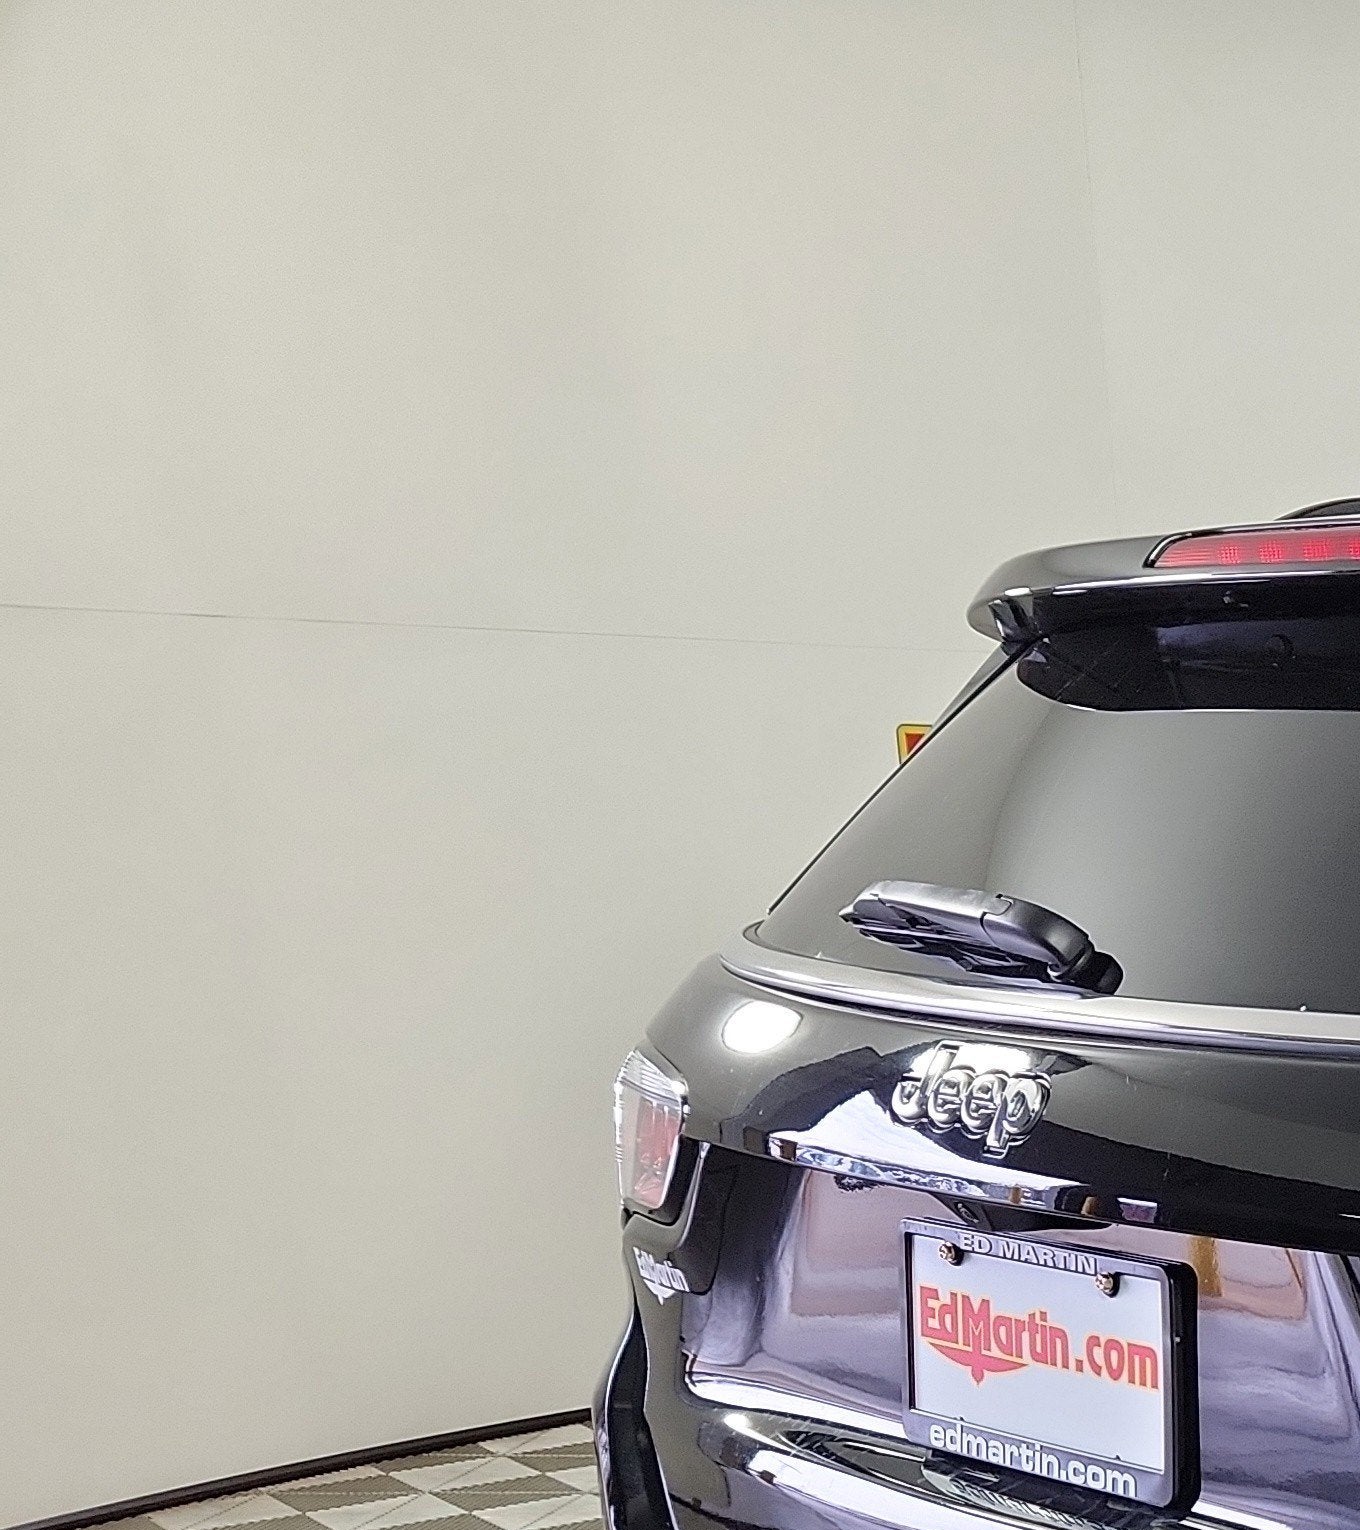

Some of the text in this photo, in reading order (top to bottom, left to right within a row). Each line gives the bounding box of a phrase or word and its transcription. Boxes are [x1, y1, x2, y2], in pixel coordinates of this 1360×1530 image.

[892, 1040, 1051, 1158] Jeep
[960, 1233, 1098, 1277] ED MARTIN
[929, 1420, 1137, 1499] edmartin.com
